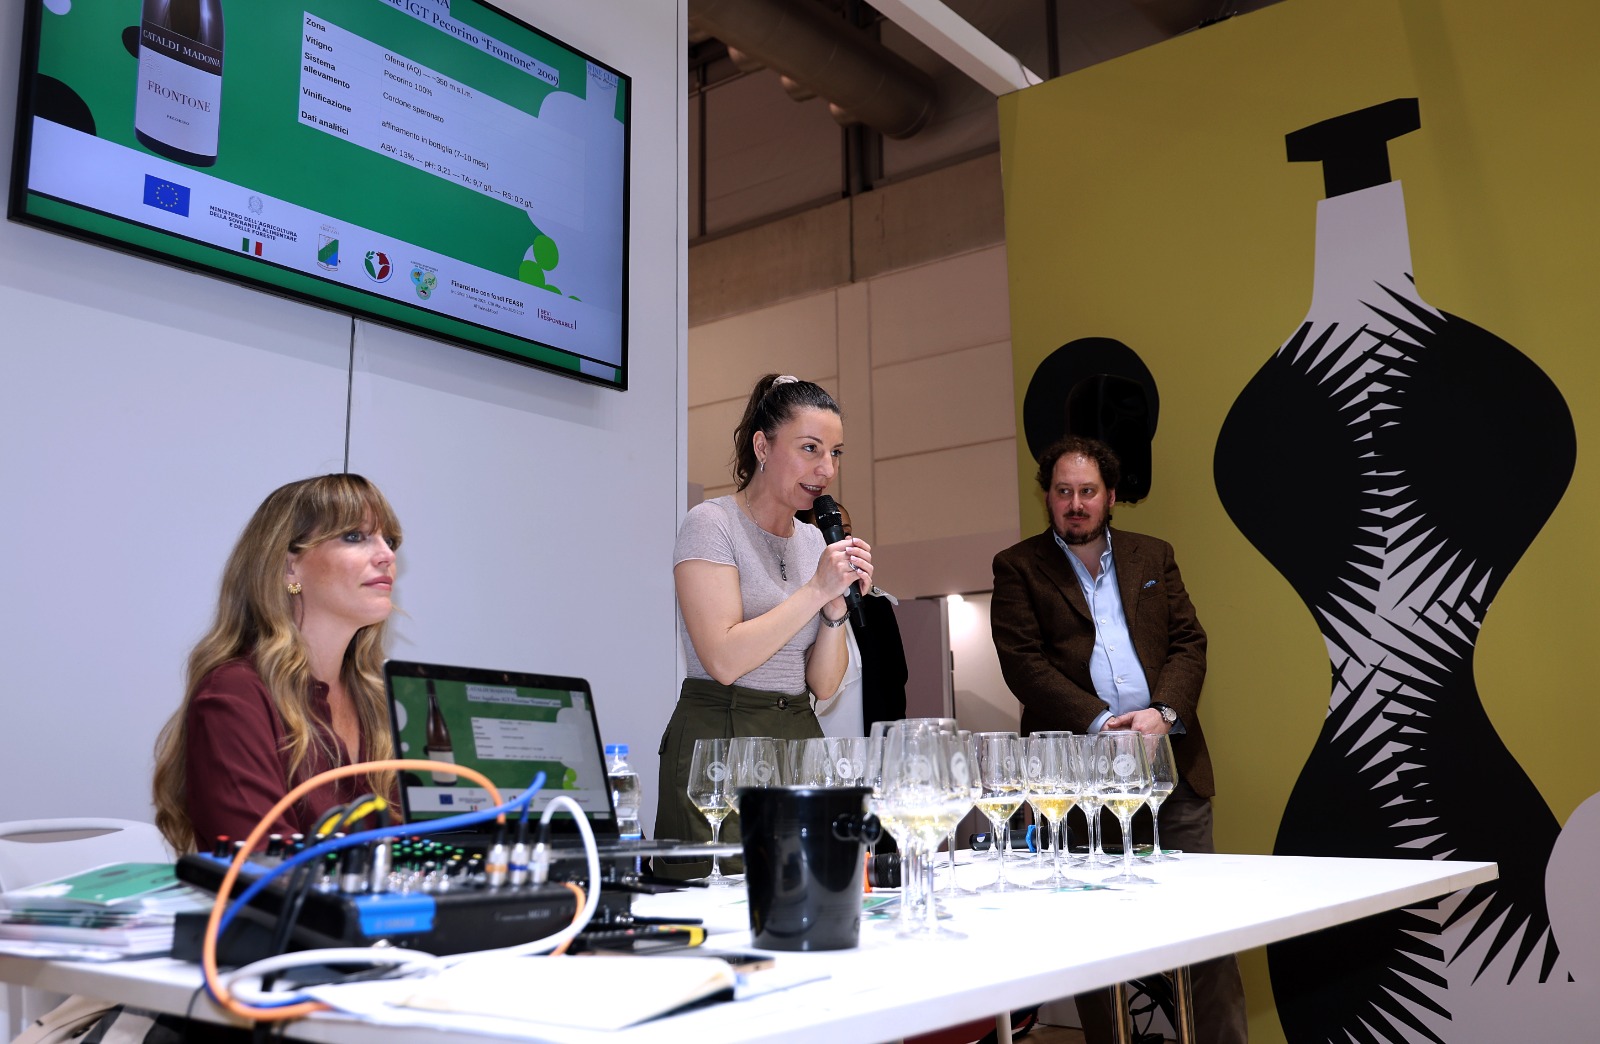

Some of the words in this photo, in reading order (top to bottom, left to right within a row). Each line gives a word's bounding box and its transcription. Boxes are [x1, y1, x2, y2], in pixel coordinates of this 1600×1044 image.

[306, 17, 326, 32] Zona
[143, 29, 180, 52] CATALDI
[305, 34, 333, 52] Vitigno
[405, 0, 430, 19] IGT
[432, 12, 479, 44] Pecorino
[537, 67, 559, 87] 2009
[304, 52, 336, 71] Sistema
[384, 53, 405, 68] Ofena
[406, 63, 422, 77] (AQ)
[303, 65, 350, 89] allevamento
[383, 69, 413, 88] Pecorino
[414, 83, 433, 96] 100%
[147, 80, 211, 113] FRONTONE
[302, 87, 352, 113] Vinificazione
[382, 91, 411, 110] Cordone
[412, 105, 444, 123] speronato
[301, 110, 317, 123] Dati
[318, 118, 349, 136] analitici
[381, 120, 420, 141] affinamento
[421, 135, 428, 144] in
[428, 138, 453, 154] bottiglia
[472, 157, 489, 170] mesi)
[380, 142, 398, 155] ABV:
[399, 149, 415, 161] 13%
[424, 160, 436, 170] pH:
[437, 164, 451, 176] 3,21
[461, 173, 472, 184] TA:
[473, 179, 483, 188] 9,7
[502, 190, 513, 200] RS:
[209, 205, 243, 220] MINISTERO
[244, 216, 298, 238] DELL'AGRICOLTURA
[209, 210, 228, 221] DELLA
[262, 227, 298, 243] ALIMENTARE
[233, 223, 251, 233] DELLE
[251, 229, 276, 241] FORESTE
[450, 279, 480, 294] Finanziato
[480, 290, 490, 298] con
[490, 292, 505, 303] fondi
[505, 297, 524, 309] FEASR
